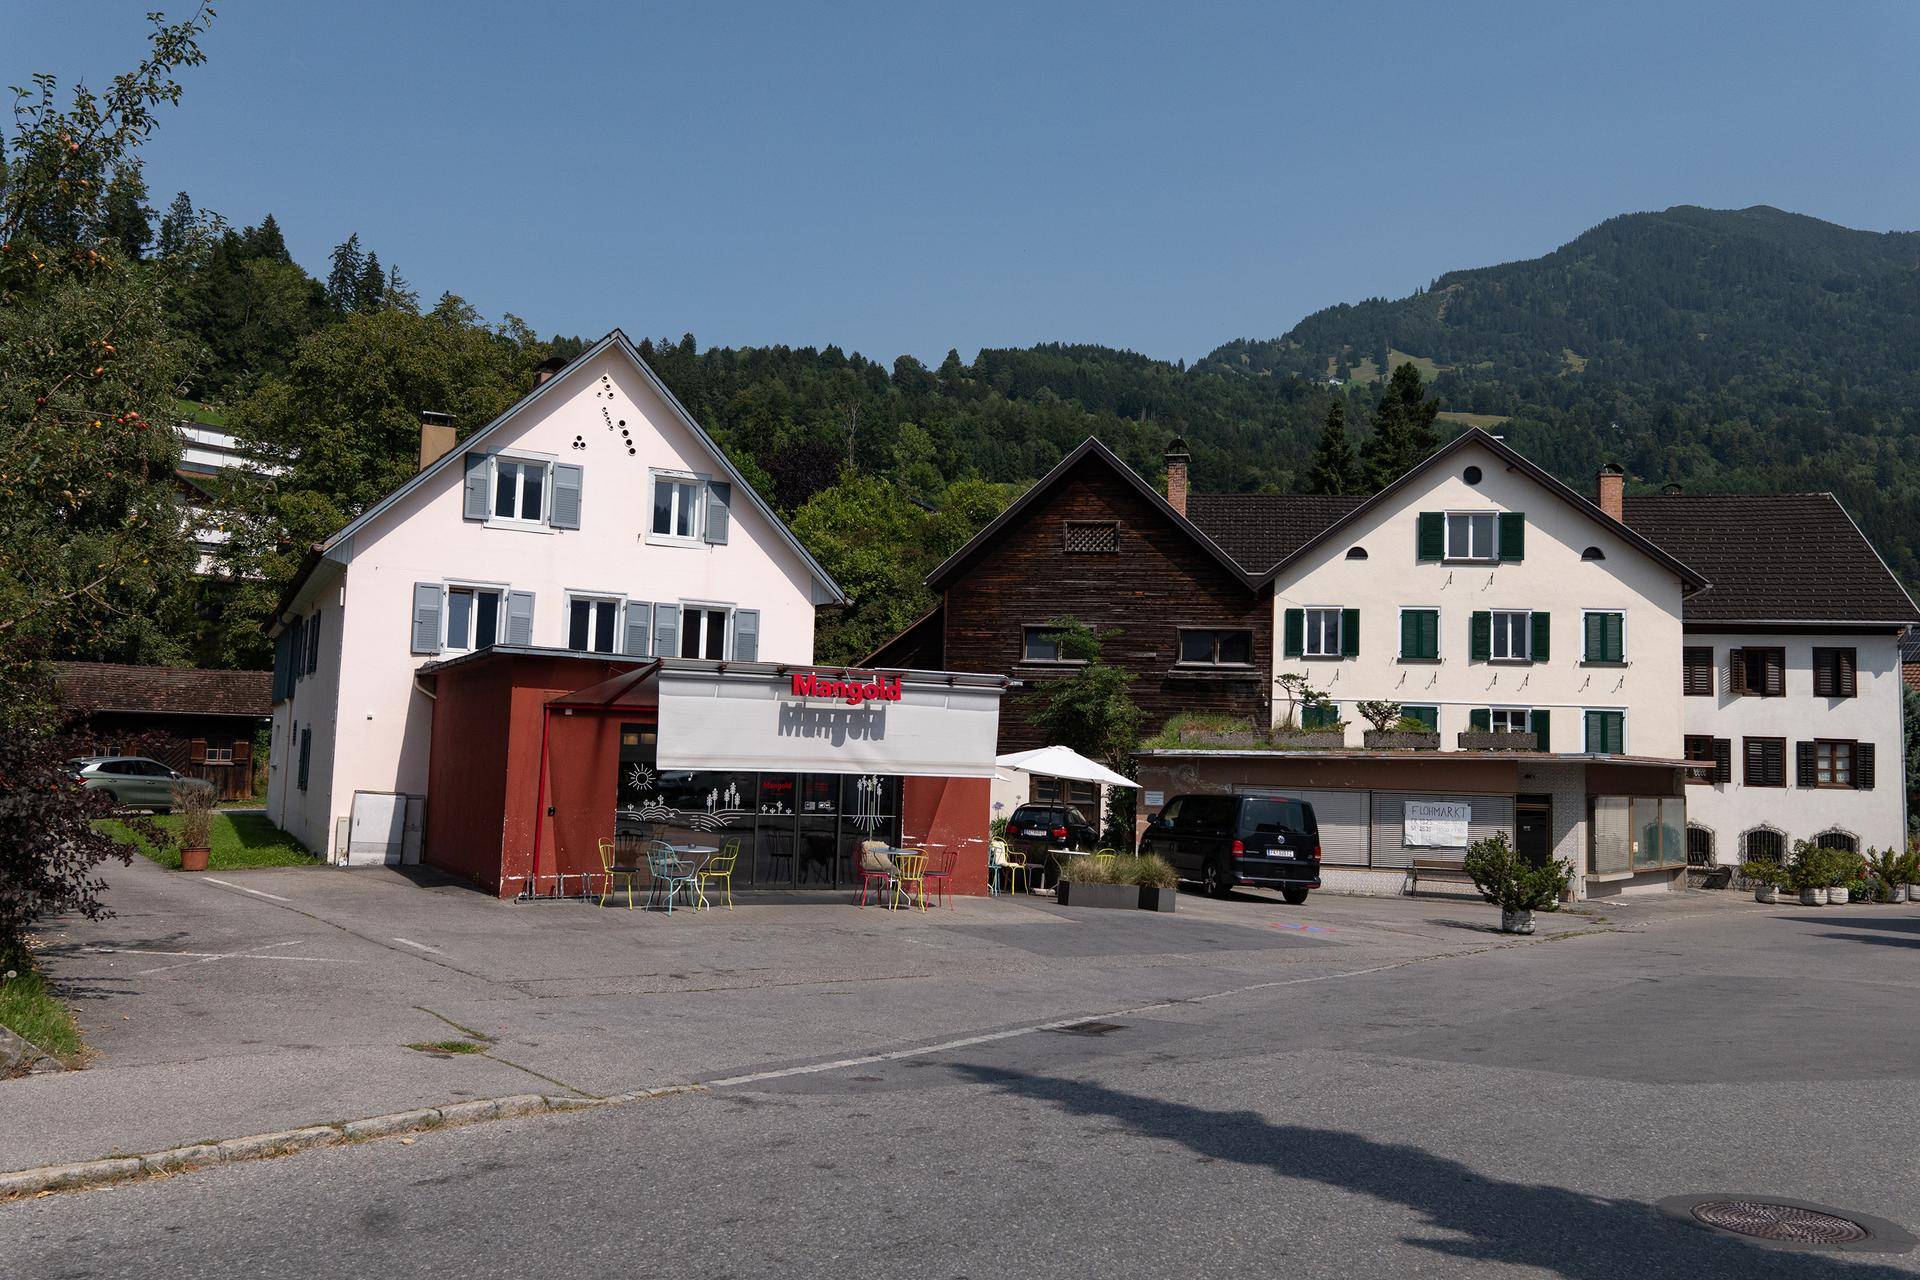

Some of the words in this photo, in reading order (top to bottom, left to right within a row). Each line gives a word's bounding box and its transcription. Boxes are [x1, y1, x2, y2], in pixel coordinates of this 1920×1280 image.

[792, 673, 901, 705] Mangold
[763, 782, 792, 790] Mangold
[1411, 805, 1467, 818] FLOHMARKT
